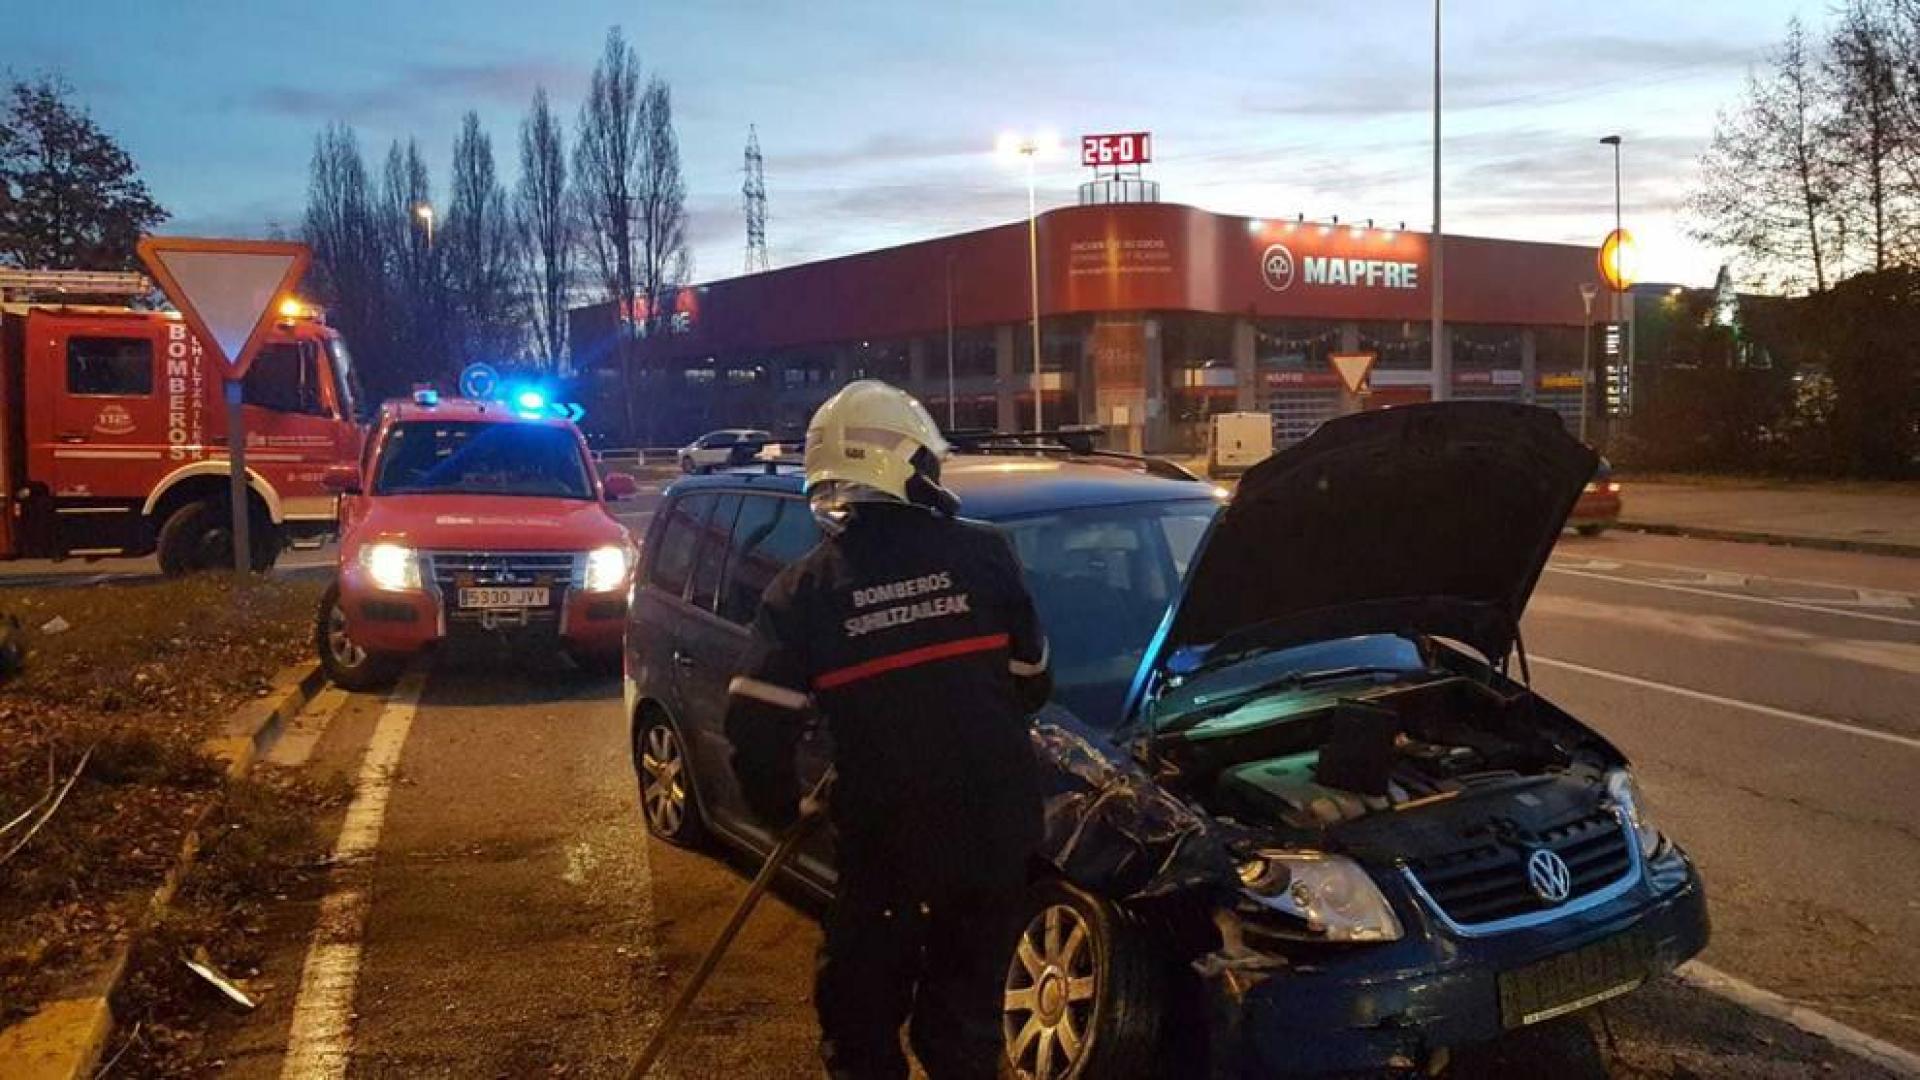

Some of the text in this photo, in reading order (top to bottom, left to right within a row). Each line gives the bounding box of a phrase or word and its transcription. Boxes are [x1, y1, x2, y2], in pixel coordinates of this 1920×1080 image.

[1303, 255, 1418, 288] MAPFRE
[168, 323, 187, 460] BOMBEROS
[853, 572, 951, 607] BOMBEROS
